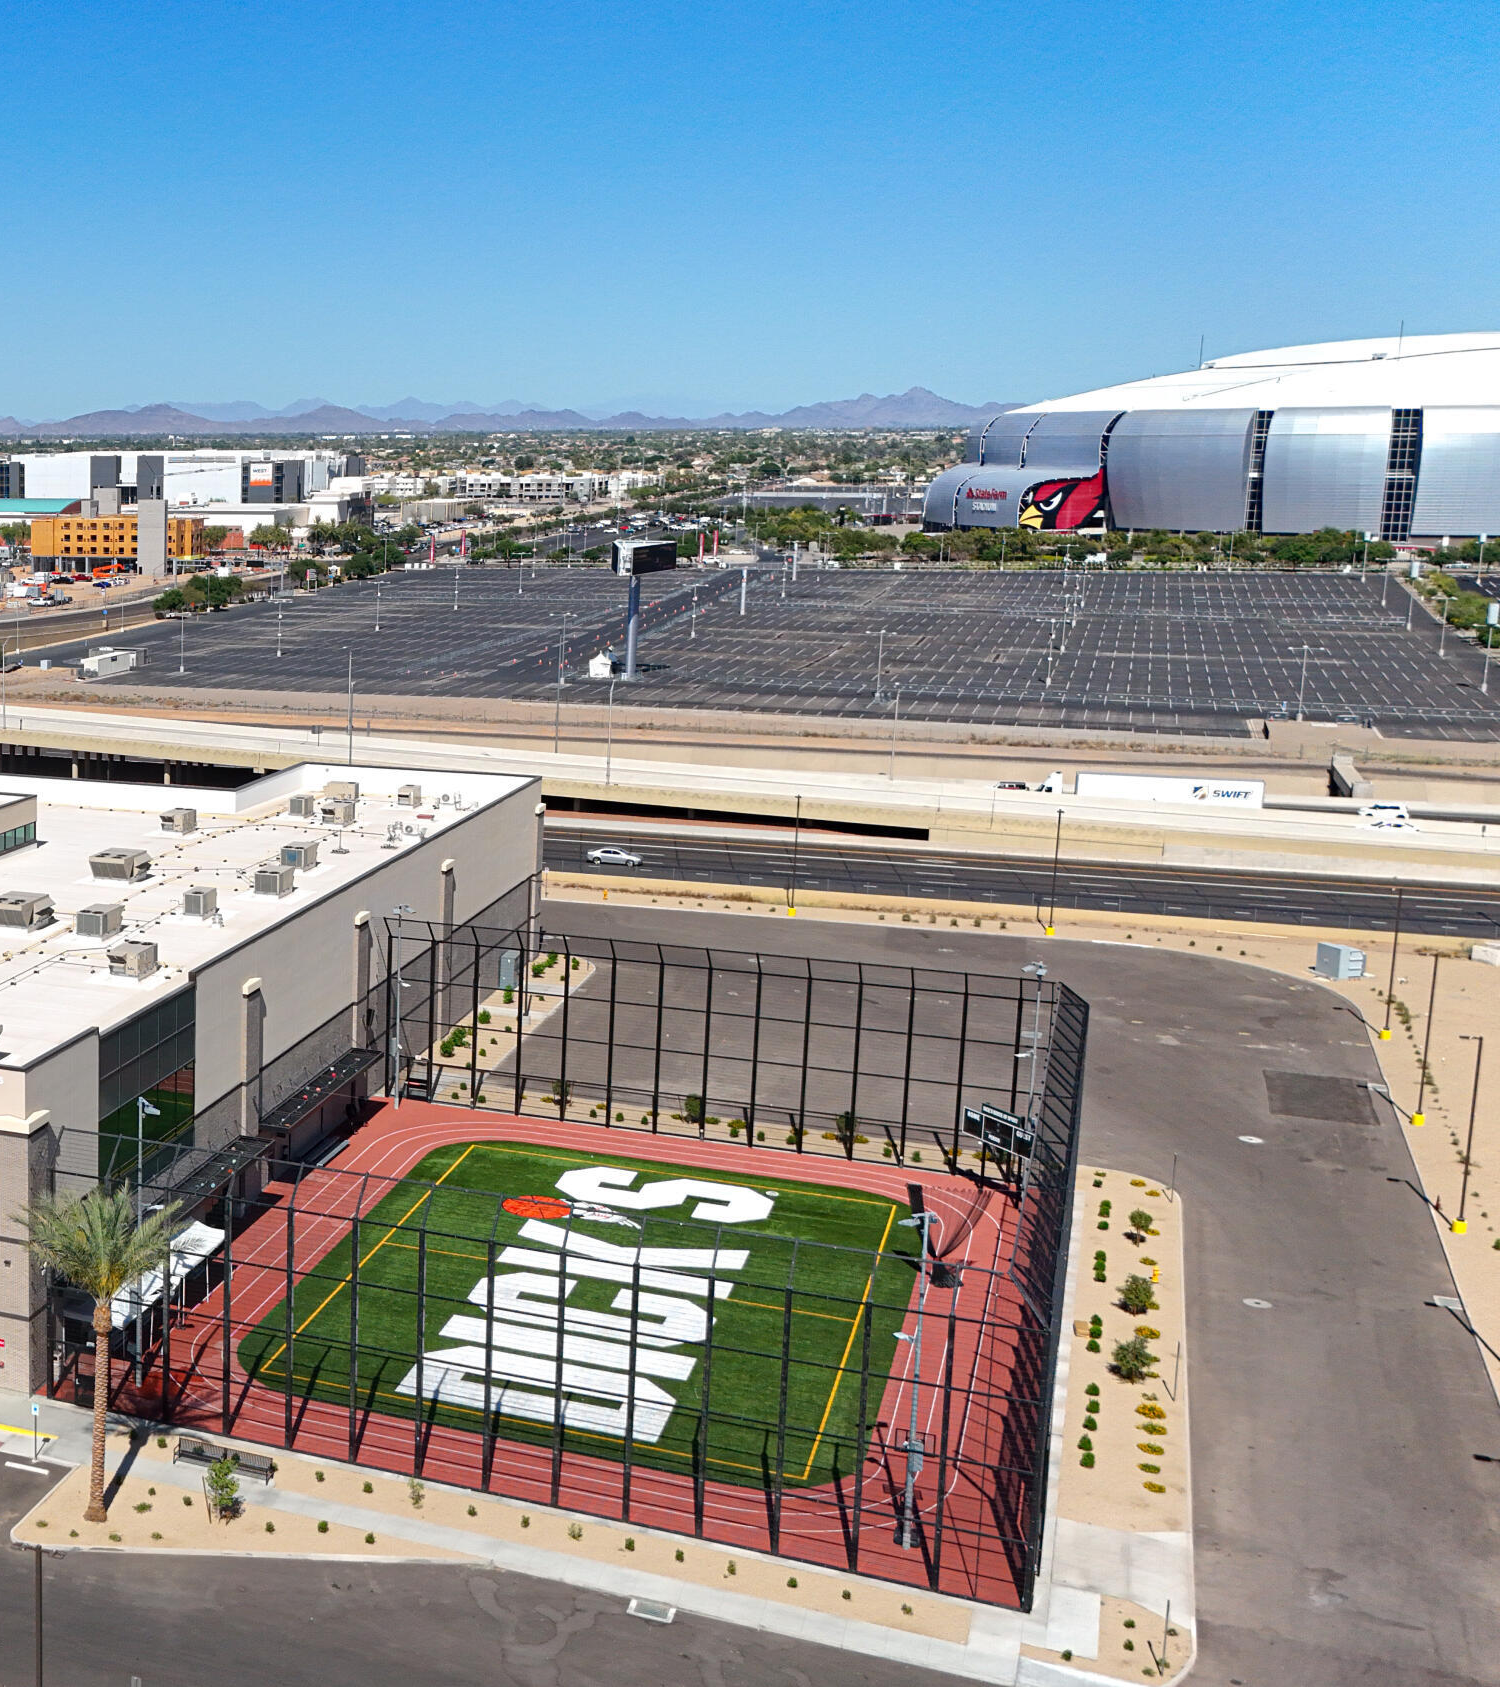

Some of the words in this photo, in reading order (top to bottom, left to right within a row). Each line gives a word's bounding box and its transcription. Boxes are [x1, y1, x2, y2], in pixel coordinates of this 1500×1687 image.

[972, 502, 996, 511] STADIUM
[1212, 789, 1252, 799] SWIFT
[395, 1166, 774, 1443] DICK'S
